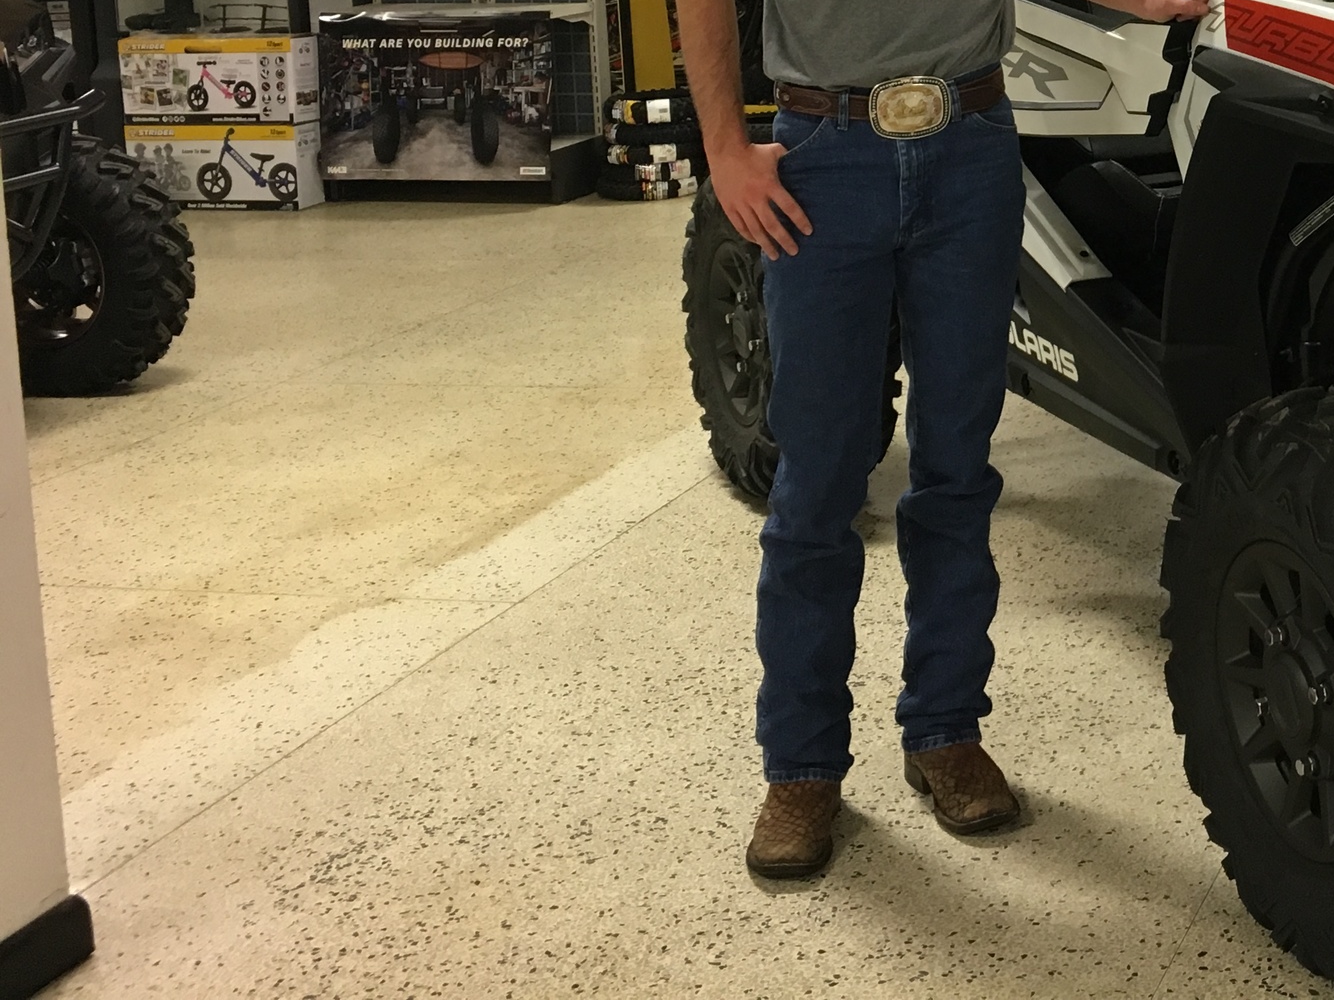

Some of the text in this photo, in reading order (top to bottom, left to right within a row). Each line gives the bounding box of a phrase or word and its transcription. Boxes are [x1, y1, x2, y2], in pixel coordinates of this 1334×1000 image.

[342, 37, 528, 49] WHAT ARE YOU BUILDING FOR?
[138, 129, 175, 137] STRIDER
[1008, 320, 1078, 382] LARIS
